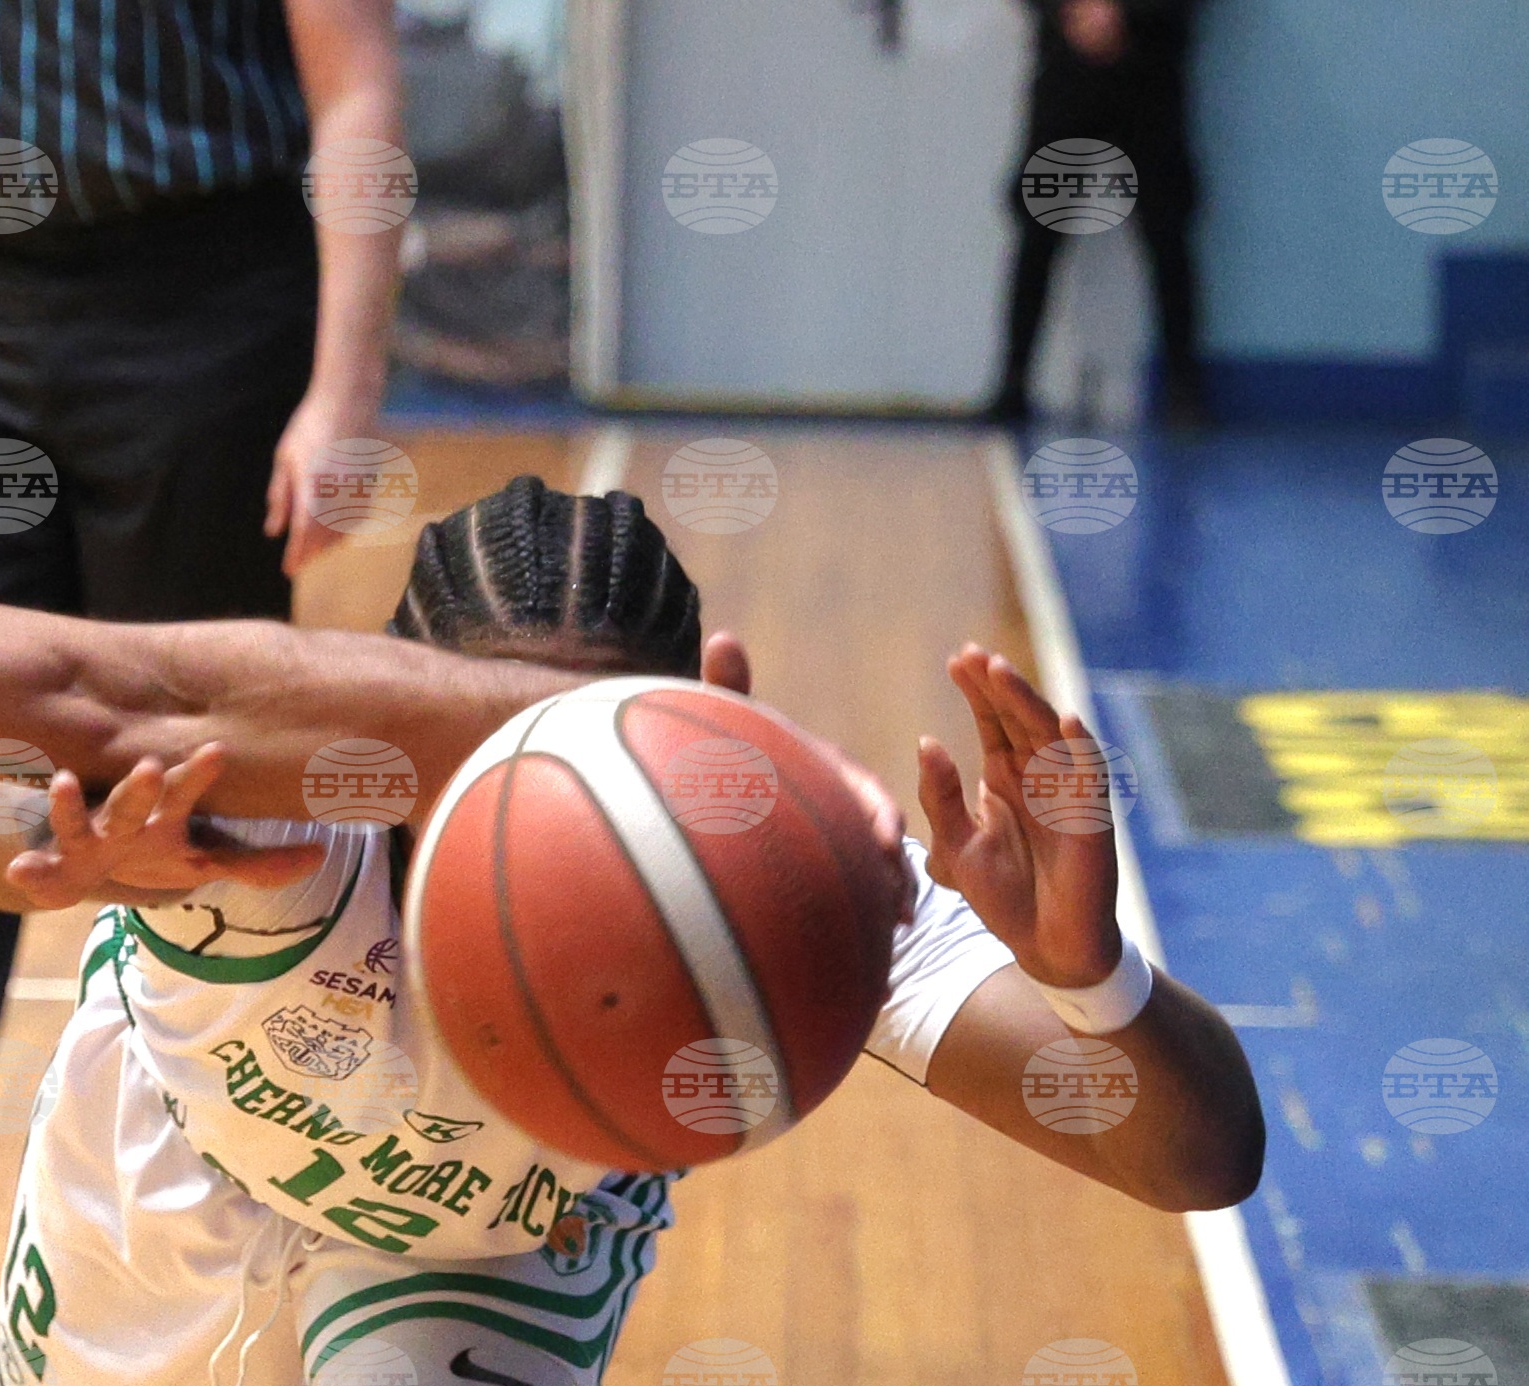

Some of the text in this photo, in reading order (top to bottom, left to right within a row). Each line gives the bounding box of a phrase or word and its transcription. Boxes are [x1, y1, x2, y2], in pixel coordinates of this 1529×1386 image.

[310, 969, 397, 1009] SESAM
[207, 1040, 366, 1146] CHERNO
[358, 1134, 493, 1217] MORE
[267, 1147, 440, 1254] 12
